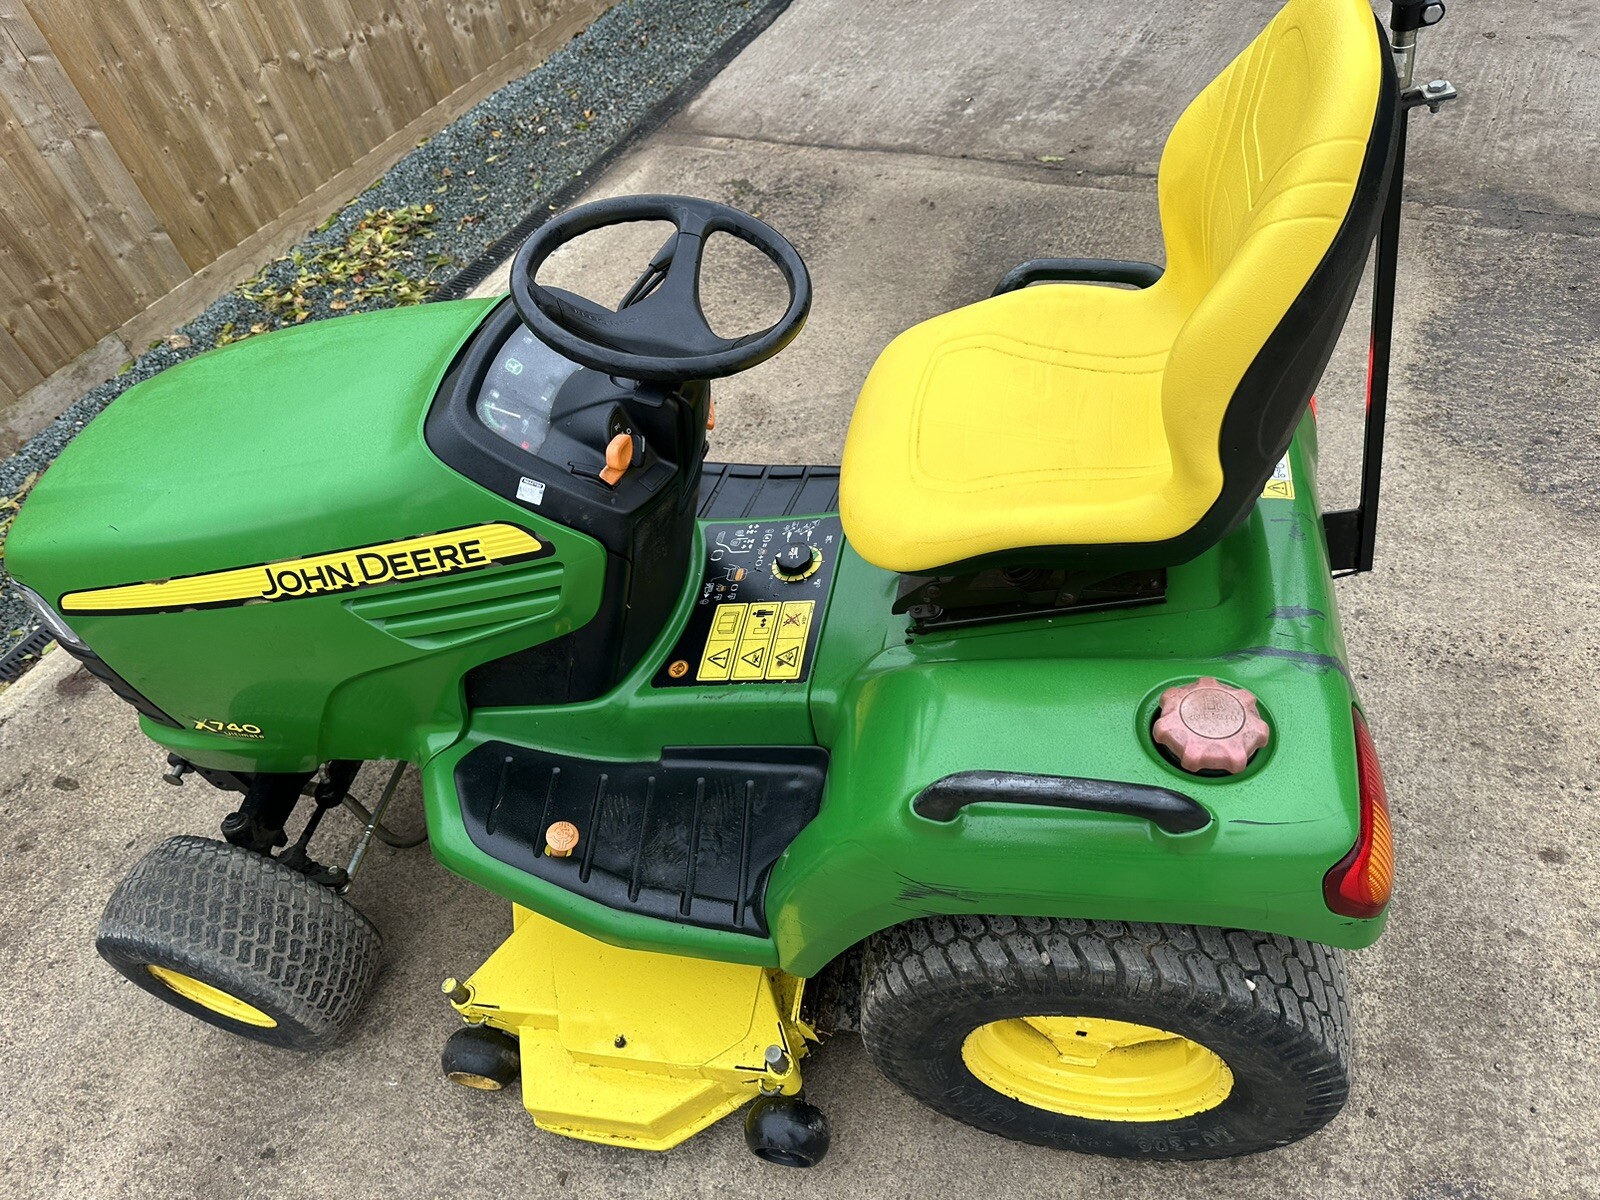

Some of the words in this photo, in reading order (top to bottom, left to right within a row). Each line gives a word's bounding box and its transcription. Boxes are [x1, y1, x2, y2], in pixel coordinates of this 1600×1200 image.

[262, 562, 354, 596] JOHN
[356, 539, 487, 582] DEERE
[194, 718, 261, 733] X740
